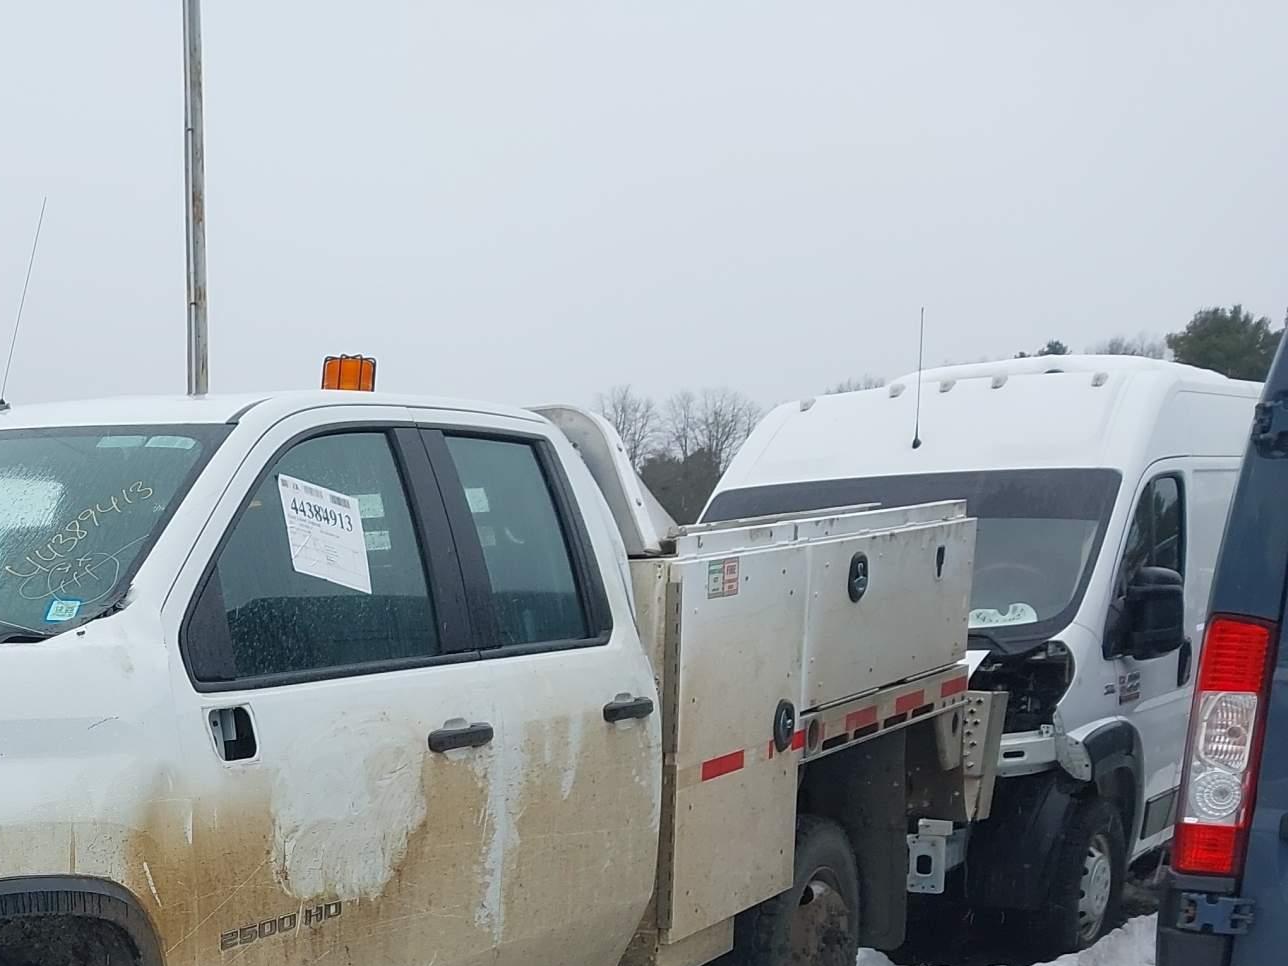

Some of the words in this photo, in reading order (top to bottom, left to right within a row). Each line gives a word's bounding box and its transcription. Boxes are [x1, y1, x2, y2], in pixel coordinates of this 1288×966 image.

[290, 497, 353, 533] 44384913
[220, 912, 297, 951] 2500
[305, 900, 342, 926] HD
